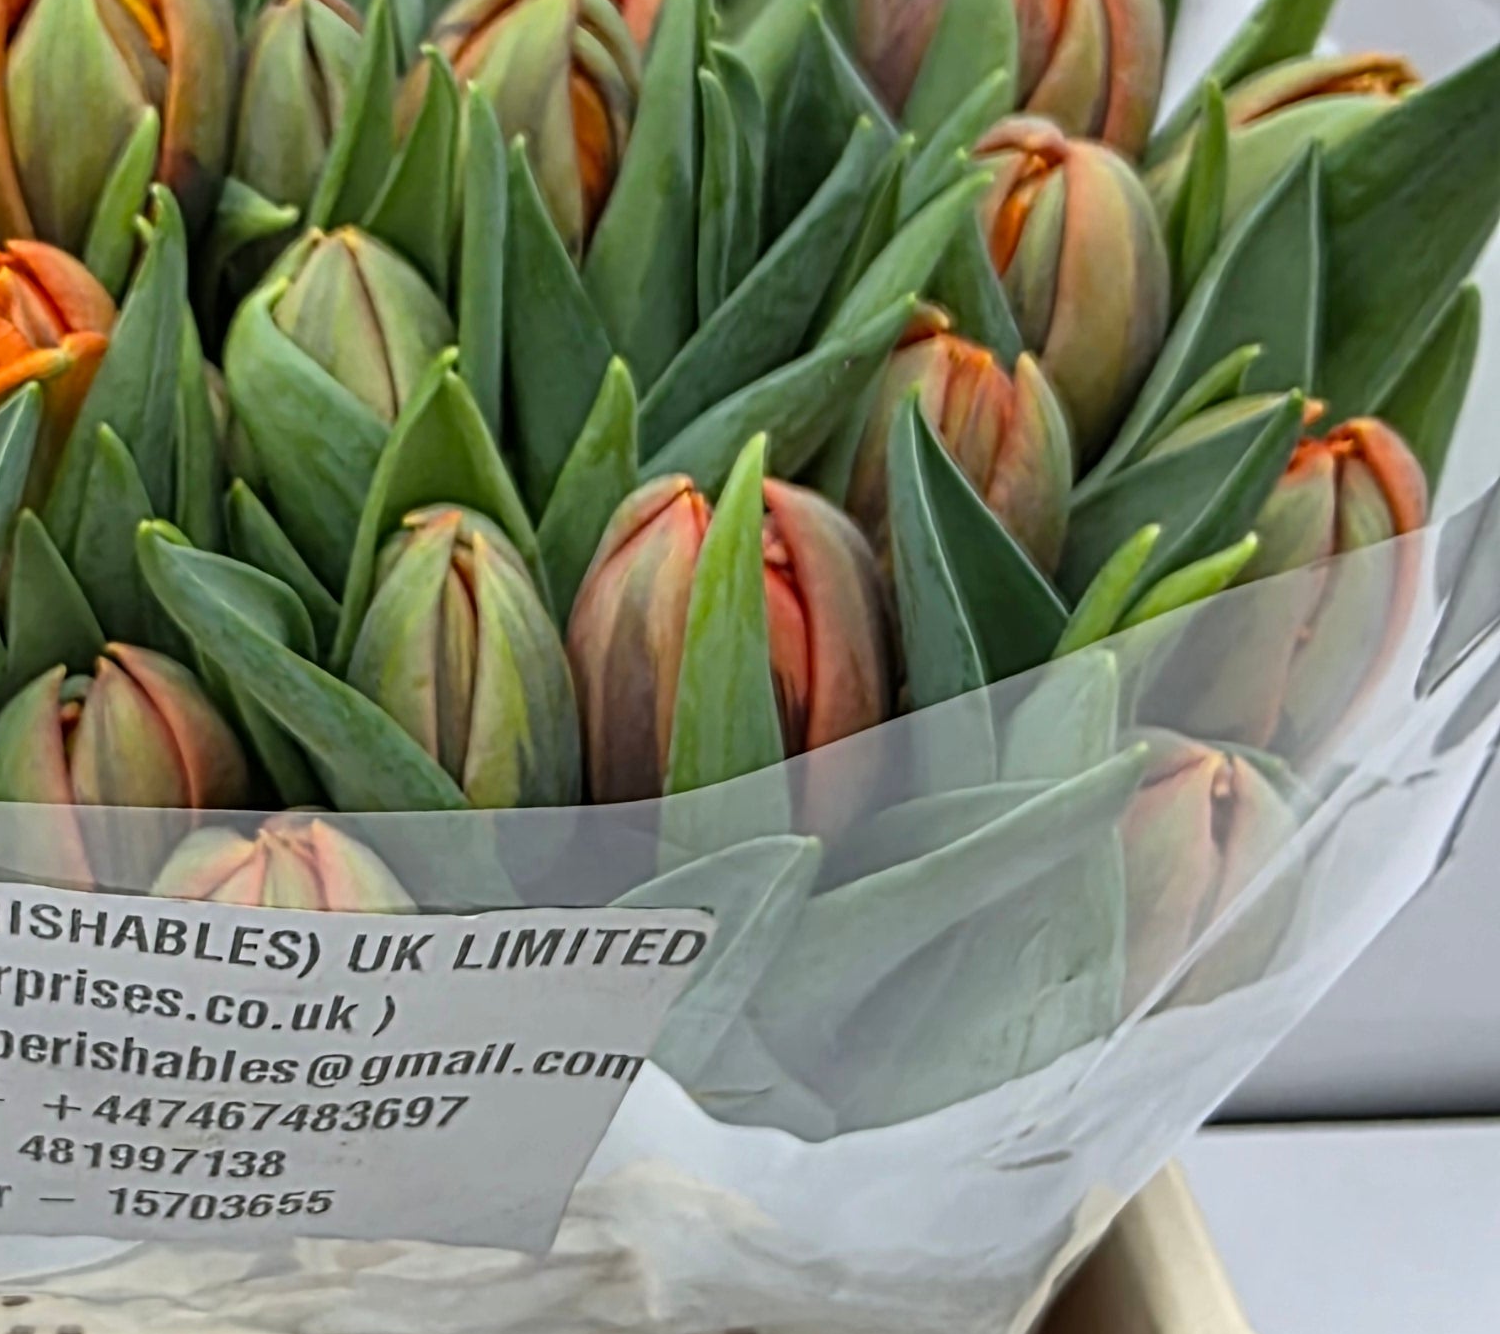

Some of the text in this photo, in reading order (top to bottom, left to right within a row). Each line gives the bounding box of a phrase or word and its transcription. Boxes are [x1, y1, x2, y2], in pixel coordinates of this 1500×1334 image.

[346, 933, 435, 972] UK
[452, 927, 708, 970] LIMITED
[42, 1093, 470, 1134] +447467483697
[18, 1134, 286, 1180] 481997138
[108, 1186, 335, 1221] 15703655
